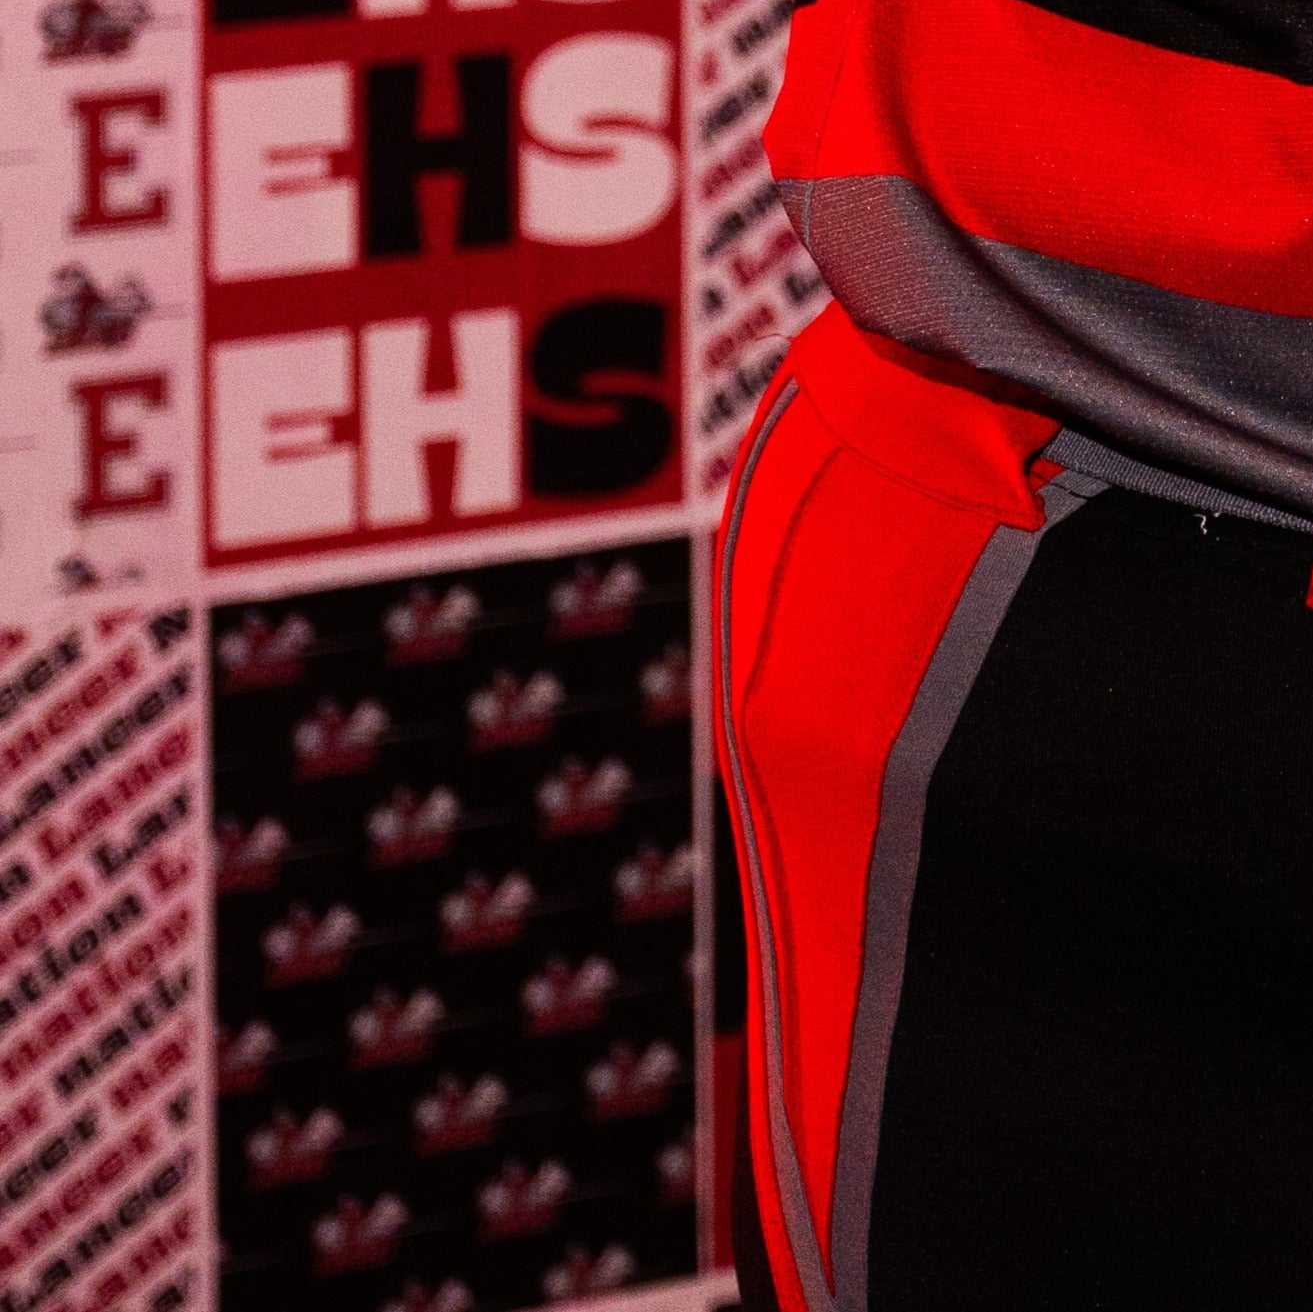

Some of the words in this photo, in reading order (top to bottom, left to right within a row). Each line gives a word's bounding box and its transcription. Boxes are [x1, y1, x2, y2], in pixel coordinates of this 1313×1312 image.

[69, 87, 172, 237] E
[210, 31, 681, 284] EHS
[70, 373, 172, 523] E
[211, 298, 675, 550] EHS
